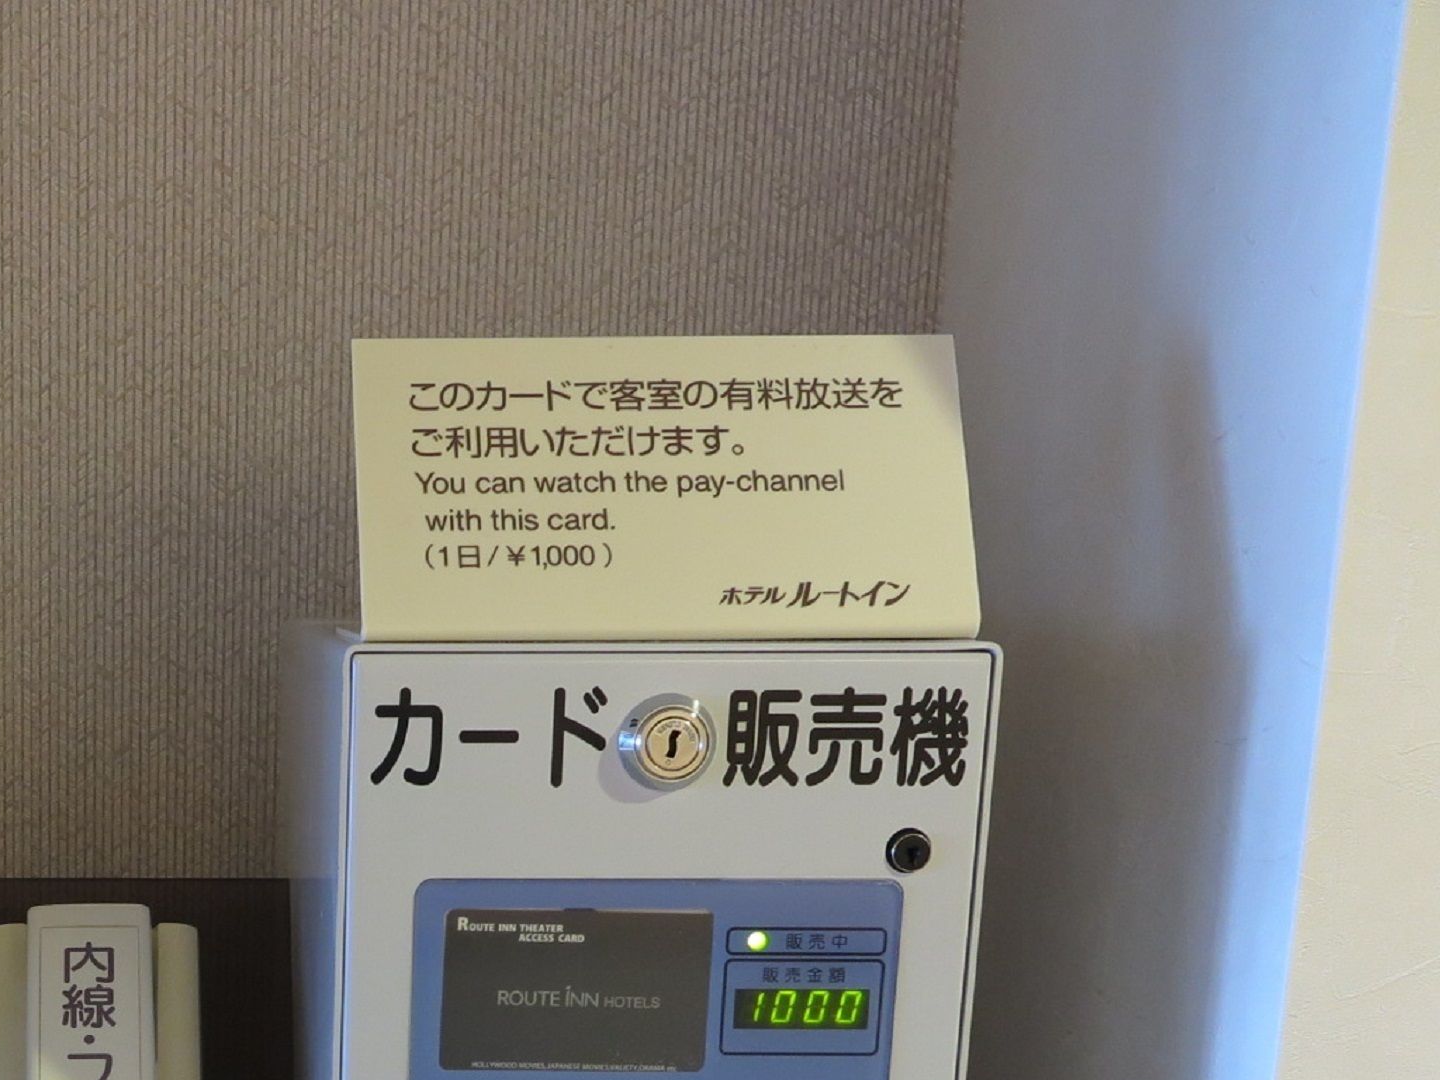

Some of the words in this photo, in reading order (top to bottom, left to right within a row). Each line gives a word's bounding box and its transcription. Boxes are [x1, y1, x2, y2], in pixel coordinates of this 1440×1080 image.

[409, 377, 904, 412] このカードで客室の有料放送を
[411, 424, 745, 459] ご利用いただけます。
[415, 471, 466, 494] You
[475, 475, 526, 493] can
[534, 470, 616, 493] watch
[624, 470, 668, 492] the
[676, 468, 846, 498] pay-channel
[425, 508, 482, 531] with
[490, 508, 540, 531] this
[547, 508, 616, 531] card.
[786, 580, 911, 608] ルートイン
[370, 686, 608, 788] カード
[722, 686, 970, 788] 販売機
[499, 923, 517, 932] INN
[519, 923, 564, 933] THEATER
[518, 933, 555, 943] ACCESS
[558, 933, 585, 943] CARD
[785, 933, 848, 949] 販売中
[762, 967, 846, 983] 販売金額
[497, 989, 560, 1007] ROUTE
[603, 995, 661, 1009] HOTELS
[753, 990, 863, 1023] 1000
